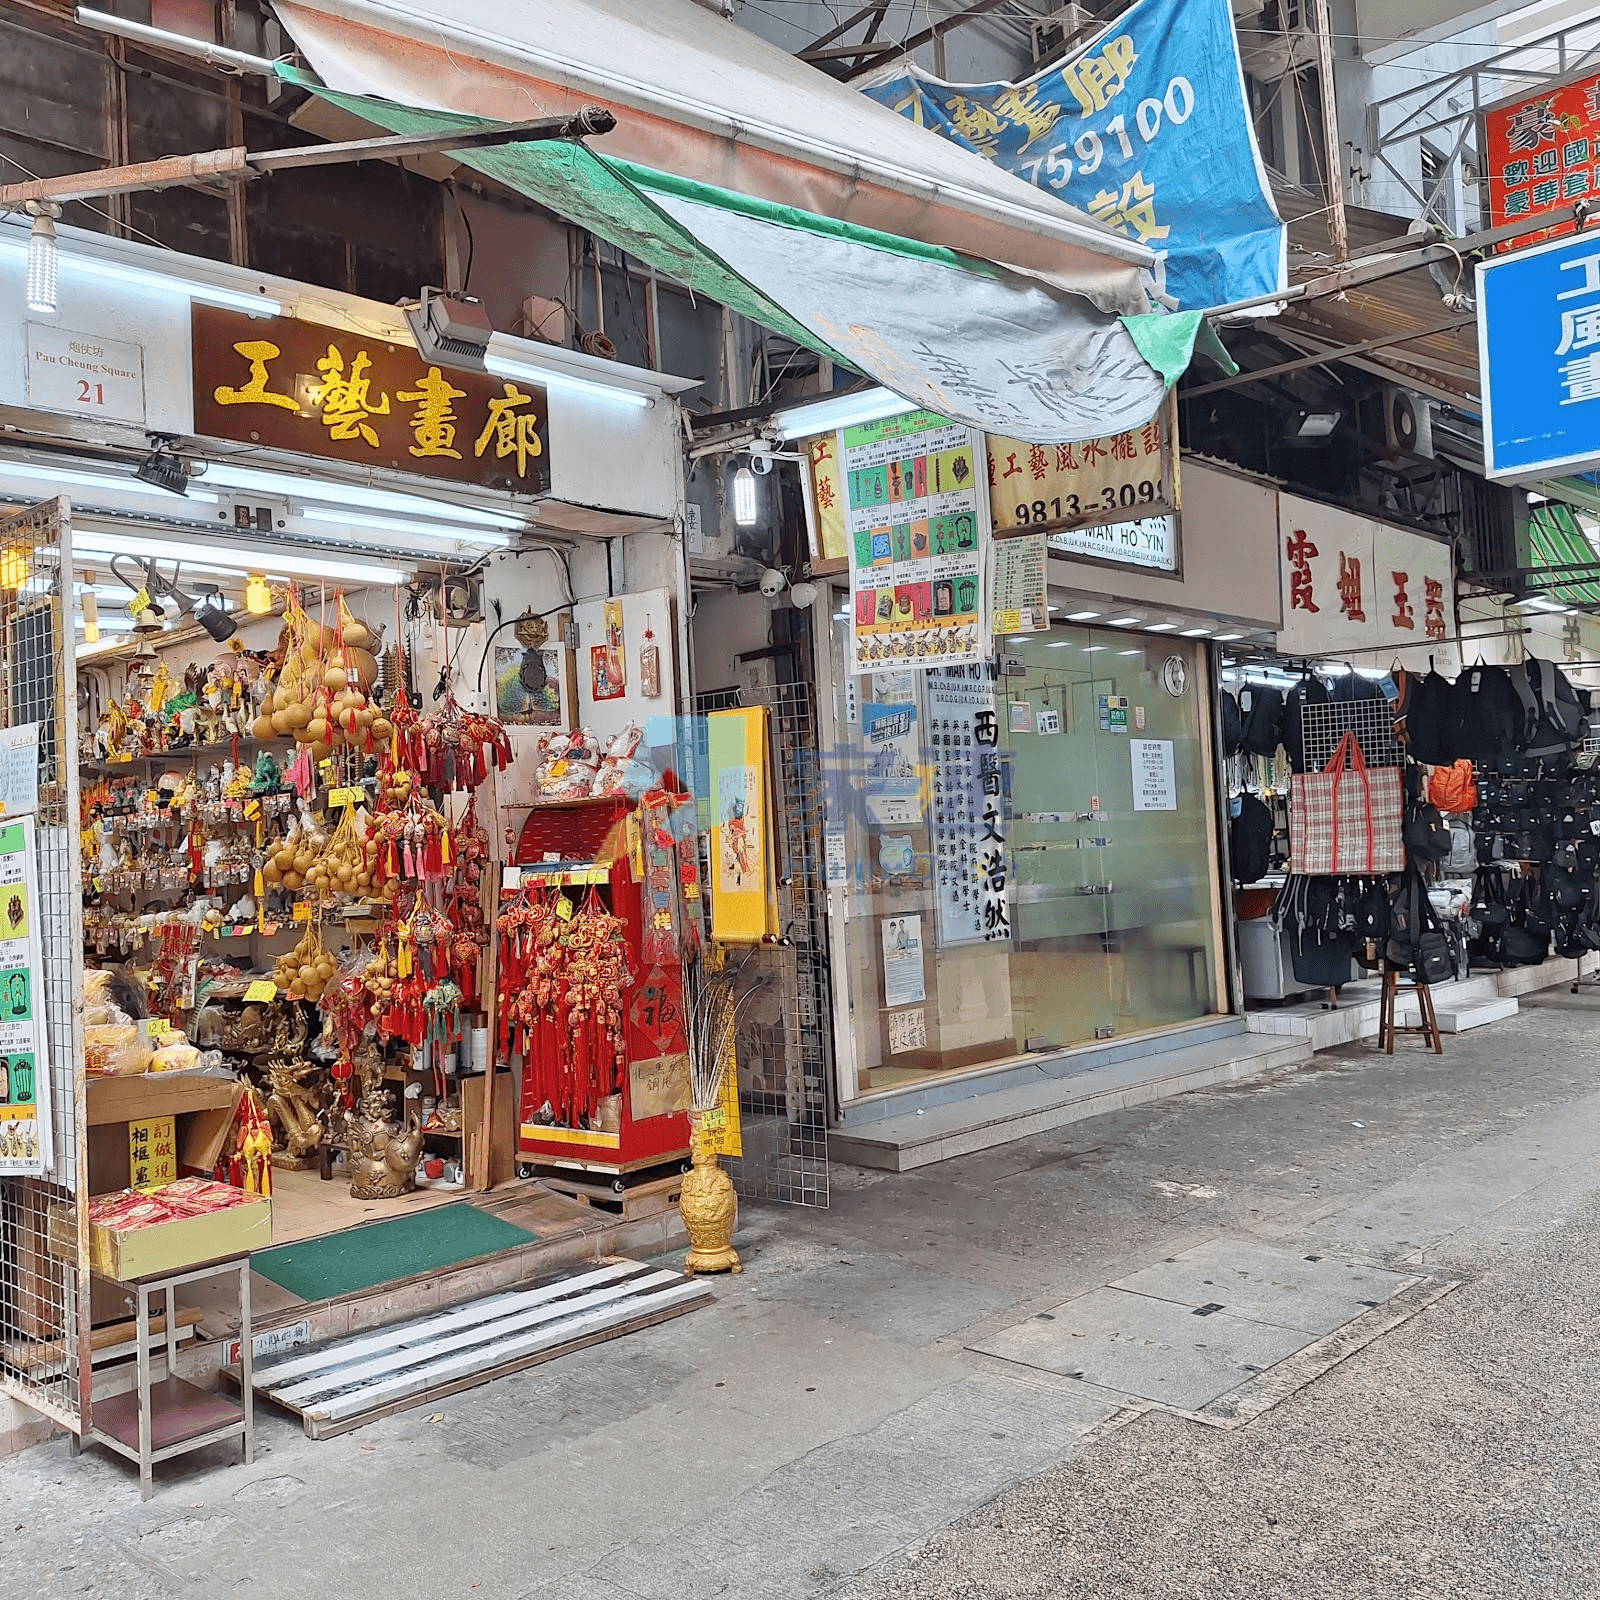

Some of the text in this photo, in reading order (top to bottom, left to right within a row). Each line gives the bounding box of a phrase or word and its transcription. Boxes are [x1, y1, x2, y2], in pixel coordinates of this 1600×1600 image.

[1007, 76, 1195, 188] 759100
[1503, 137, 1600, 187] 歡迎國
[35, 351, 136, 379] Pau Cheung Square
[68, 340, 104, 358] 炮仗坊
[76, 379, 106, 406] 21
[213, 339, 543, 480] 工藝畫廊
[814, 443, 836, 511] 工藝
[1120, 528, 1138, 546] HO
[1145, 534, 1164, 552] YIN
[1286, 529, 1446, 641] 霞姐玉器
[969, 662, 980, 680] HO
[985, 662, 998, 681] YIN
[974, 711, 1010, 941] 西醫文浩然
[642, 984, 675, 1037] 福
[131, 1127, 151, 1187] 相框畫
[153, 1122, 175, 1184] 訂做現
